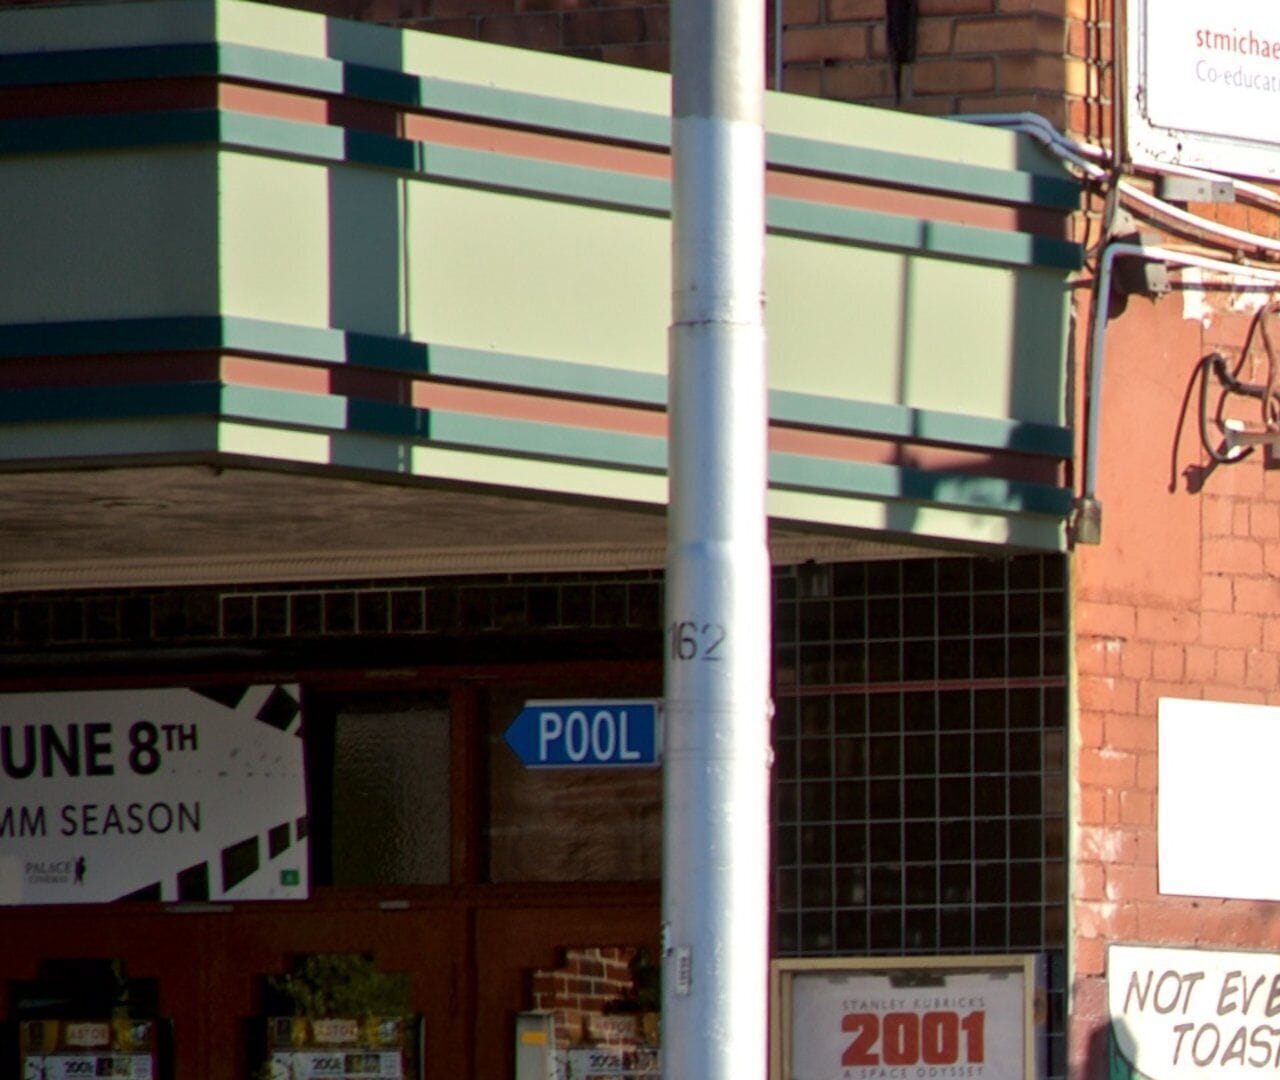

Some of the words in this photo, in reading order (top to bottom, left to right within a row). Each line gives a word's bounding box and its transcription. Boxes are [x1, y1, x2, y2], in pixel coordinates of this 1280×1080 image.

[0, 722, 115, 780] UNE
[539, 710, 641, 762] POOL
[61, 801, 201, 837] SEASON
[843, 1000, 906, 1011] STANLEY
[1123, 970, 1205, 1015] NOT
[841, 1011, 986, 1067] 2001
[844, 1069, 853, 1079] A
[860, 1068, 907, 1080] SPACE
[915, 1066, 984, 1078] ODYSSEY
